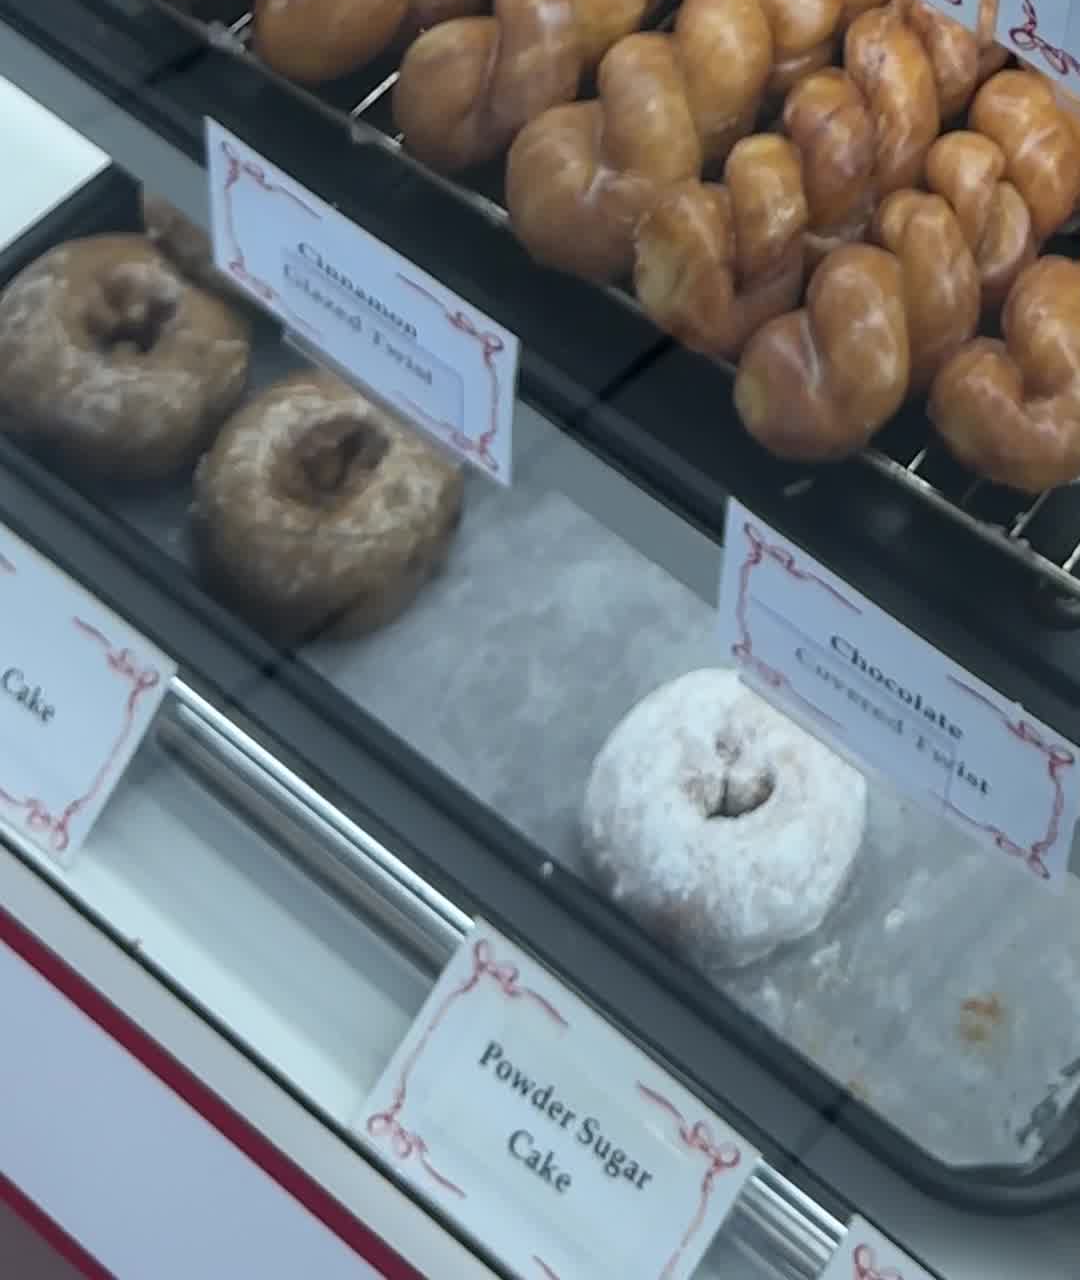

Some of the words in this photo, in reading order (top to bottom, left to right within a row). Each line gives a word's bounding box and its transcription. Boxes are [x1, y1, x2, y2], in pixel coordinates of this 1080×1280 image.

[1, 666, 55, 724] Cake
[830, 634, 965, 739] Chocolate
[916, 736, 992, 796] Twist
[478, 1040, 575, 1130] Powder
[574, 1116, 654, 1193] Sugar
[506, 1129, 573, 1195] Cake
